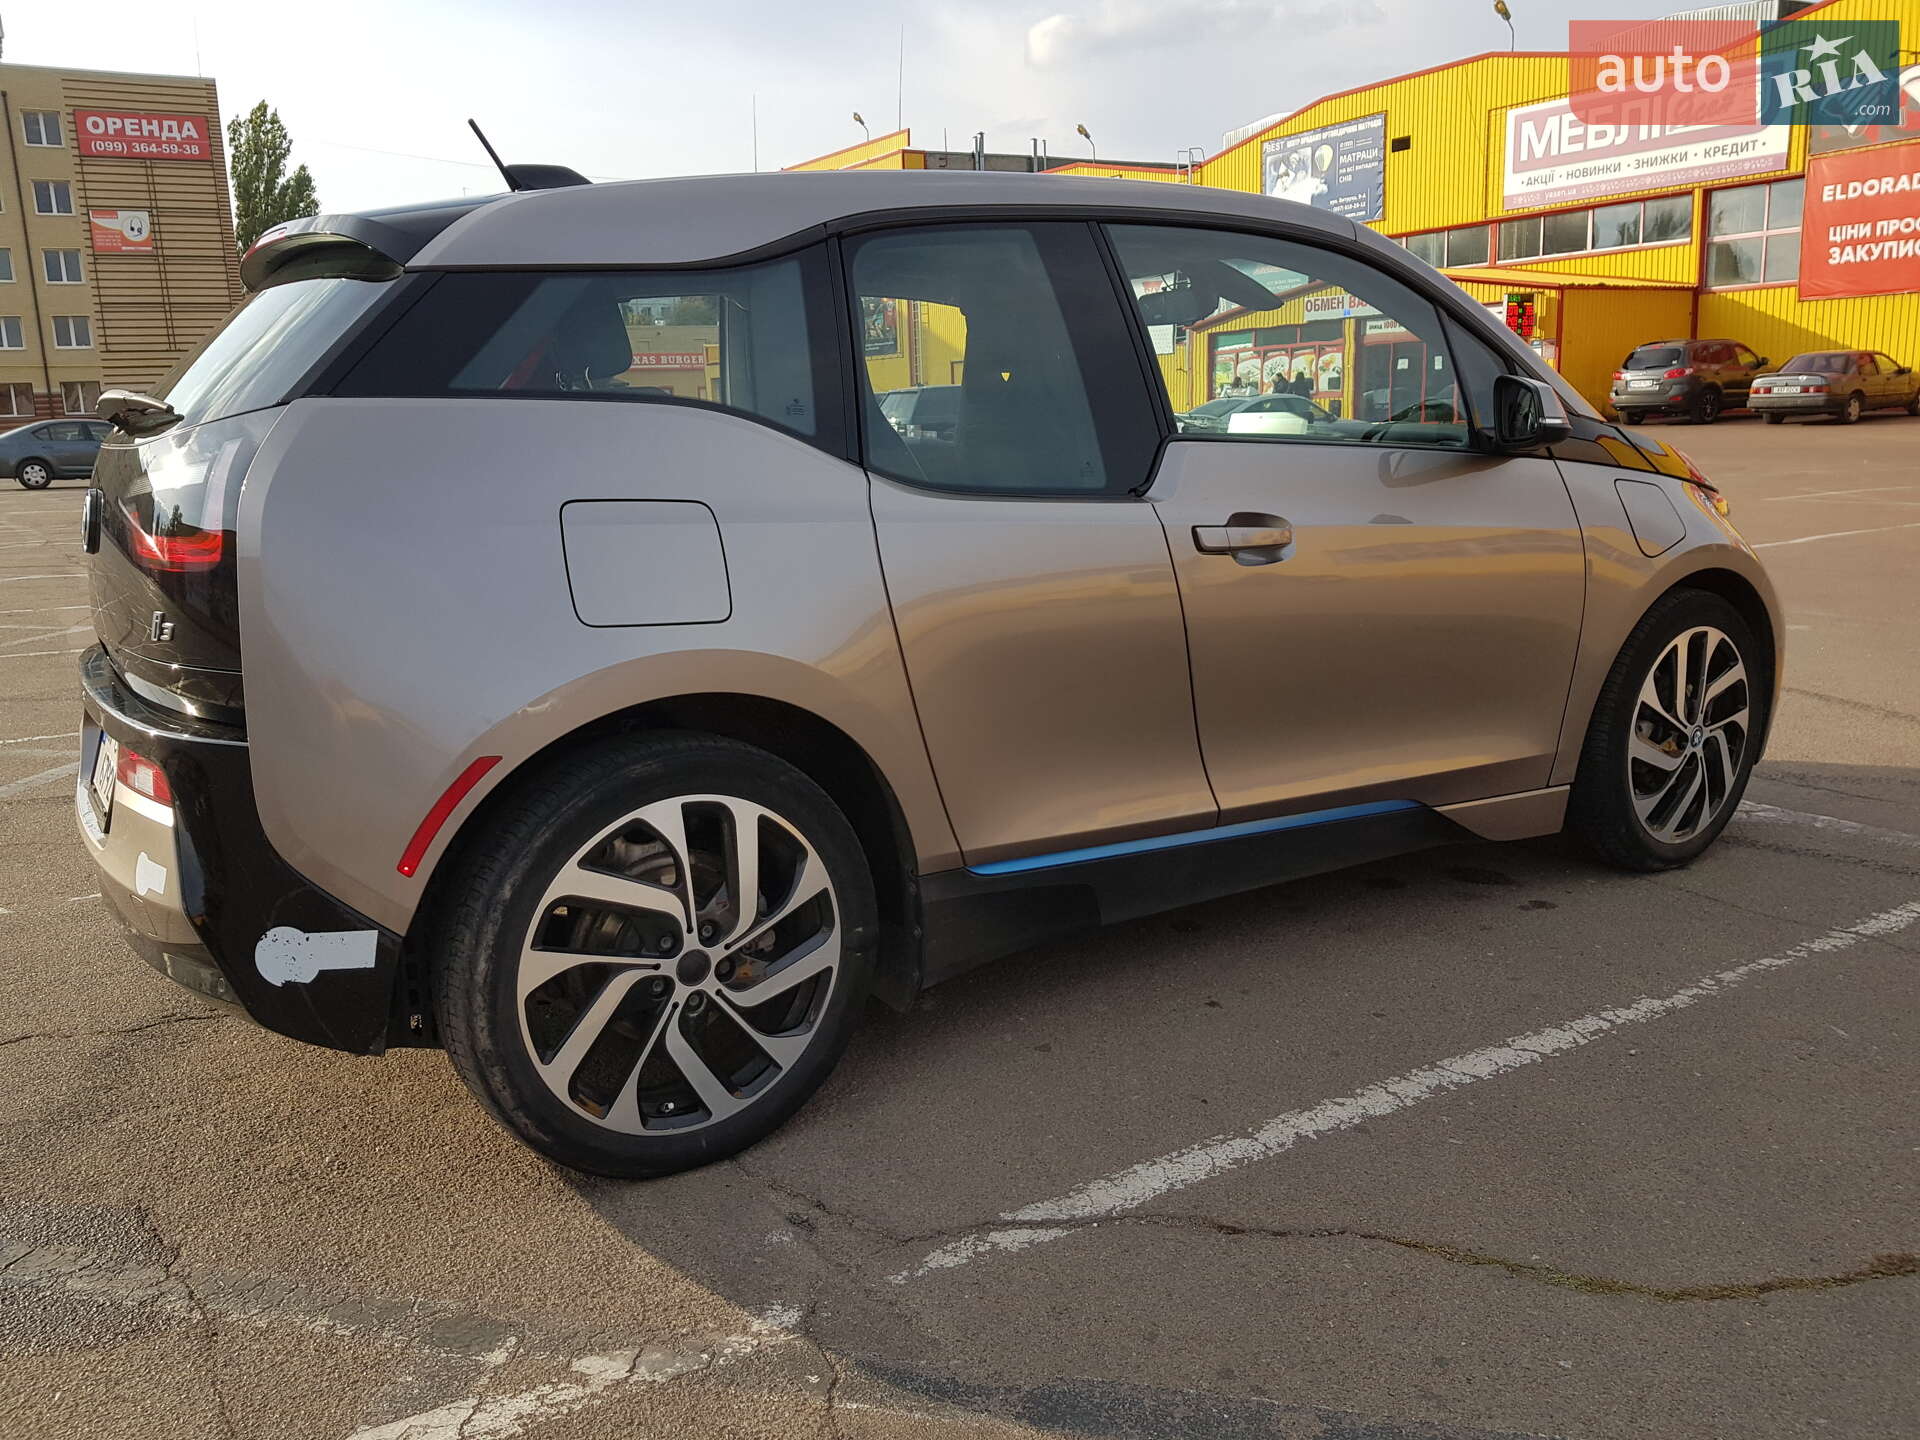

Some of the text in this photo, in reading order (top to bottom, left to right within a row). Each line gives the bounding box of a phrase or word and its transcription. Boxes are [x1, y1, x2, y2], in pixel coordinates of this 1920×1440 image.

[86, 116, 199, 141] ОРЕНДА
[91, 141, 199, 155] (099) 364-59-38
[1526, 139, 1758, 186] АКЦІЇ НОВИНКИ ЗНИЖКИ КРЕДИТ
[1829, 222, 1872, 243] ЦІНИ
[1305, 296, 1345, 313] ОБМЕН
